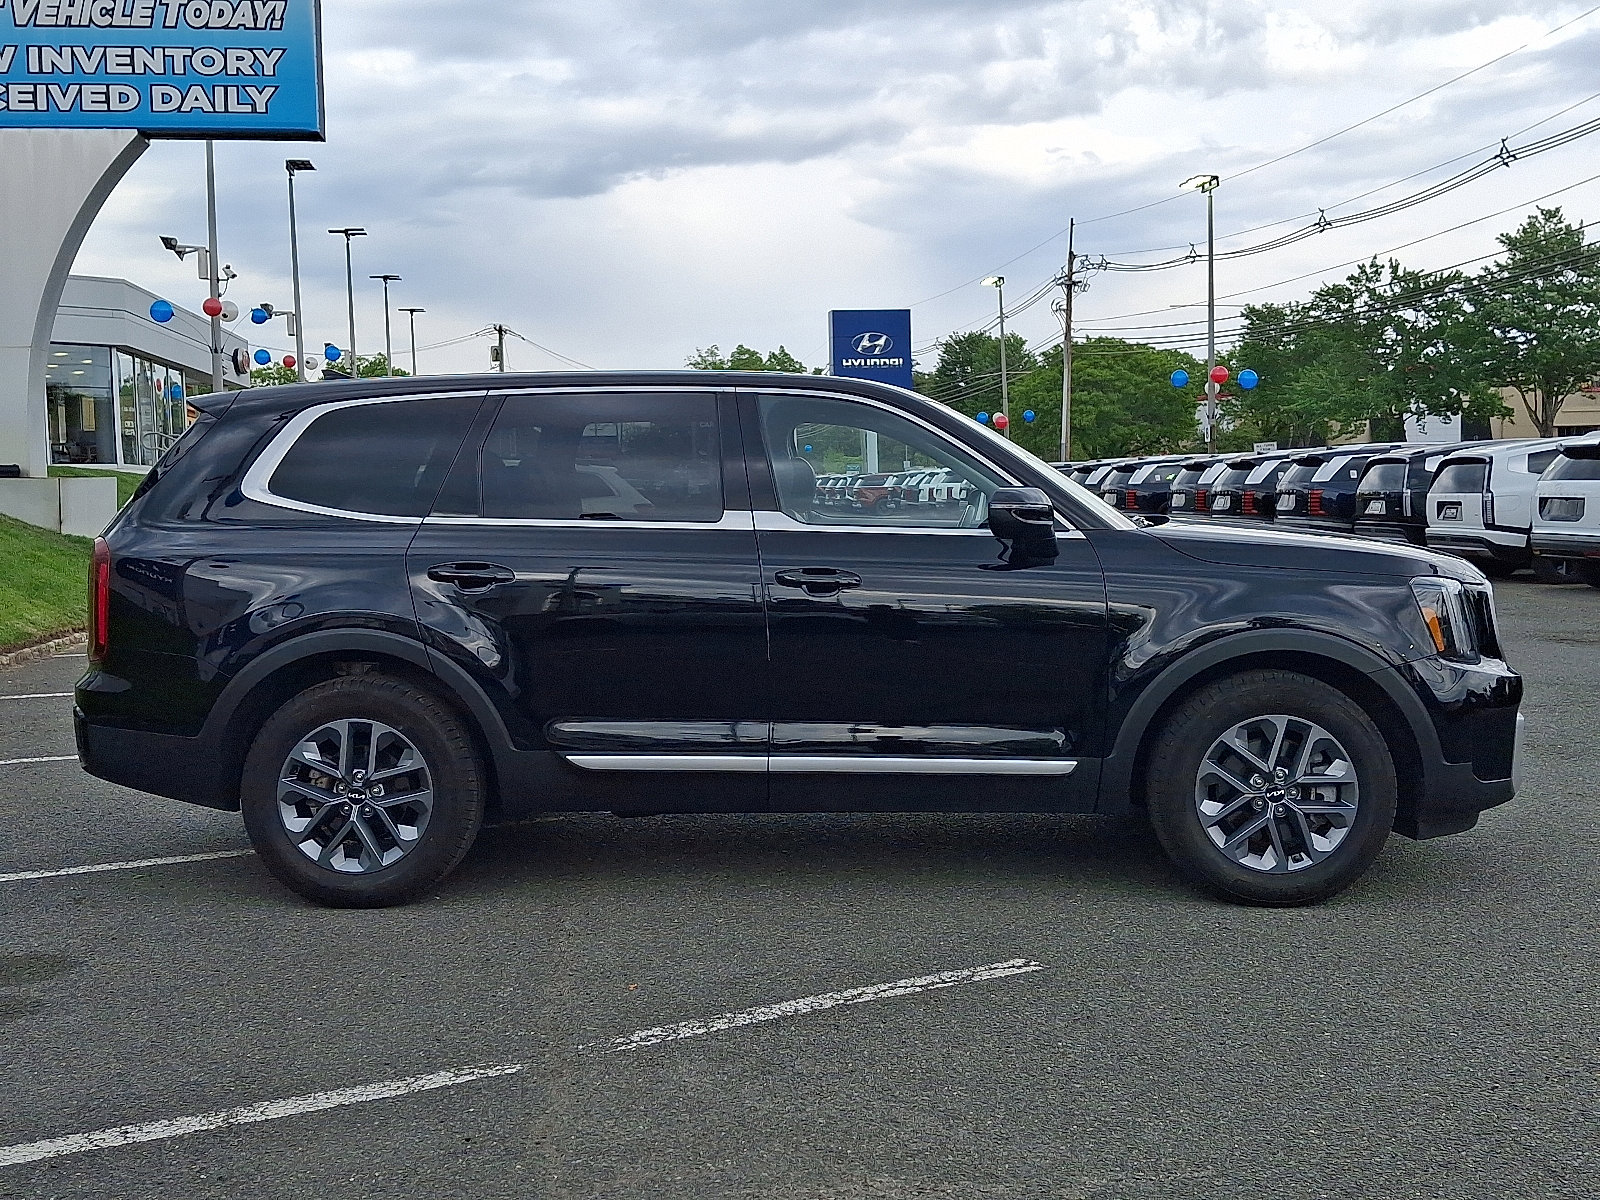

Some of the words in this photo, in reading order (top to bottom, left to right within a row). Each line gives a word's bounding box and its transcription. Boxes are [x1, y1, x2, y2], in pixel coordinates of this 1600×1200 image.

[10, 0, 156, 28] VEHICLE
[159, 0, 287, 30] TODAY!
[26, 45, 287, 76] INVENTORY
[0, 82, 141, 112] EIVED
[150, 84, 279, 114] DAILY
[842, 358, 903, 368] HYUNDAI
